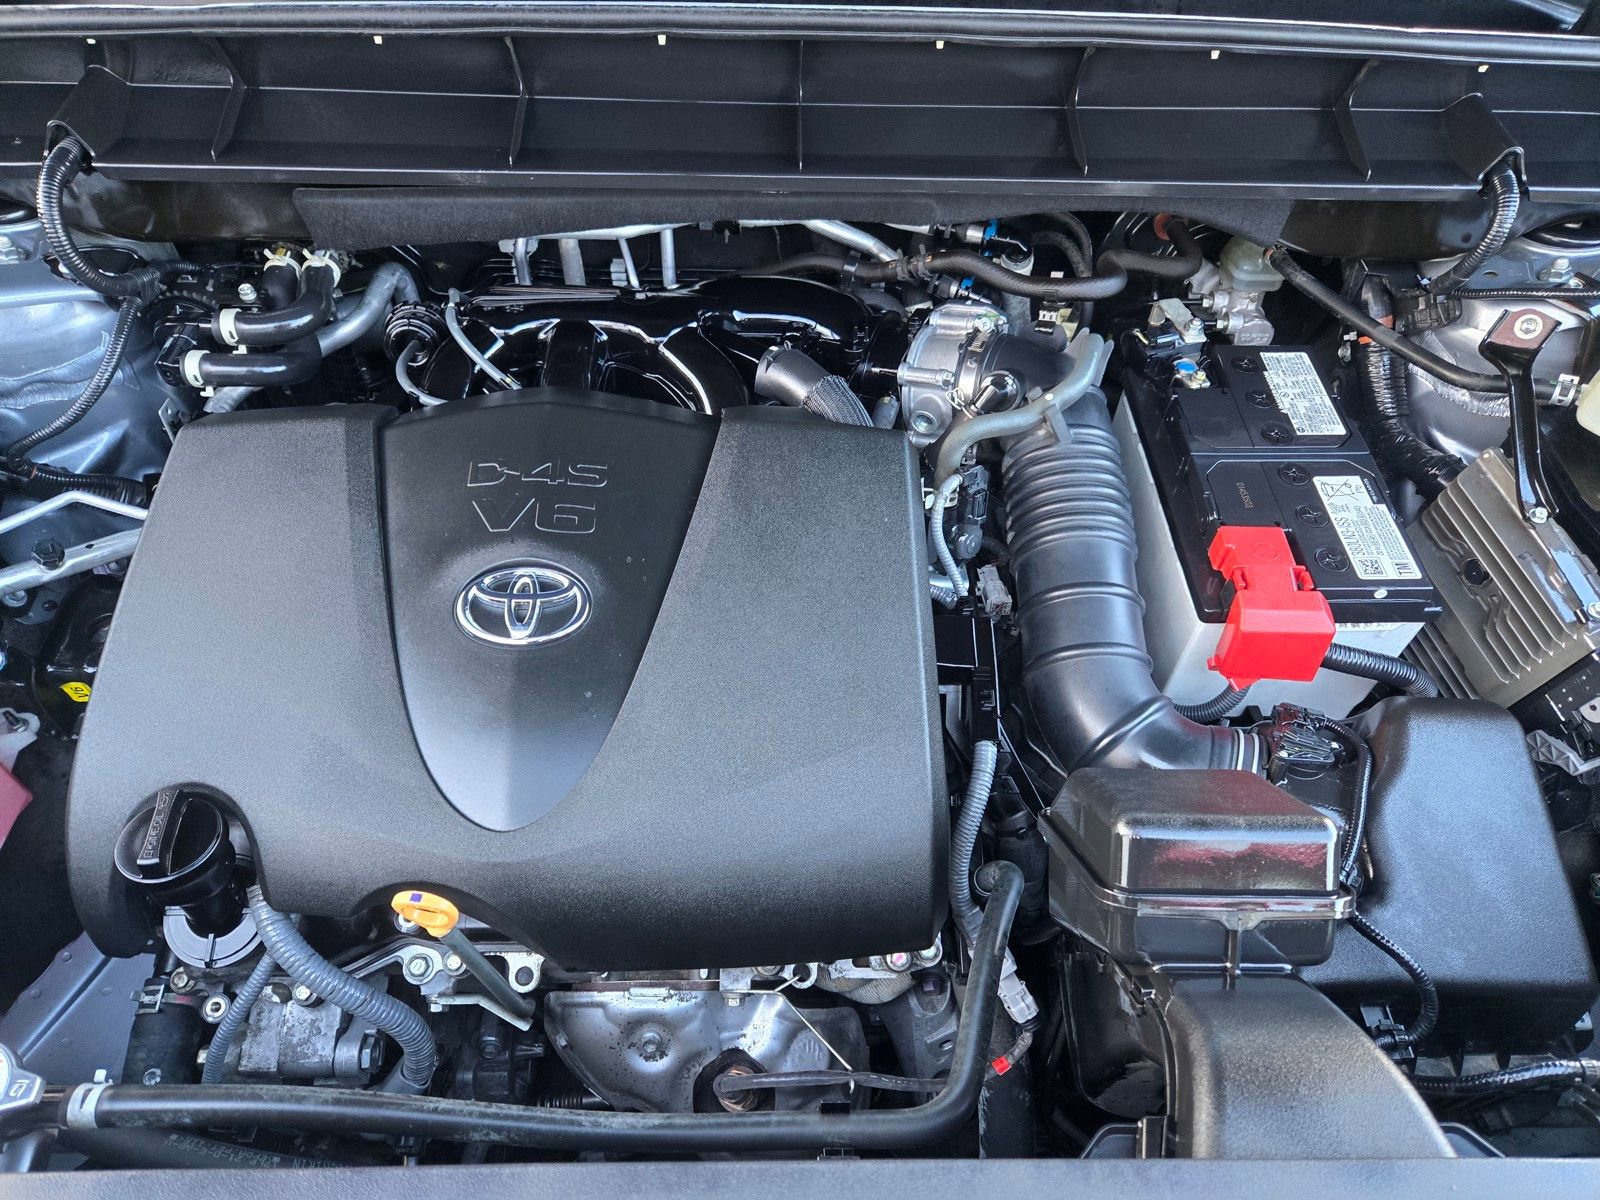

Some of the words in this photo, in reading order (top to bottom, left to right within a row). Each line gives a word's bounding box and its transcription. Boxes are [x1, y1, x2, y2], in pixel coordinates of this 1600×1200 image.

[467, 460, 608, 487] D-4S
[472, 498, 596, 533] V6
[1394, 562, 1413, 575] TM
